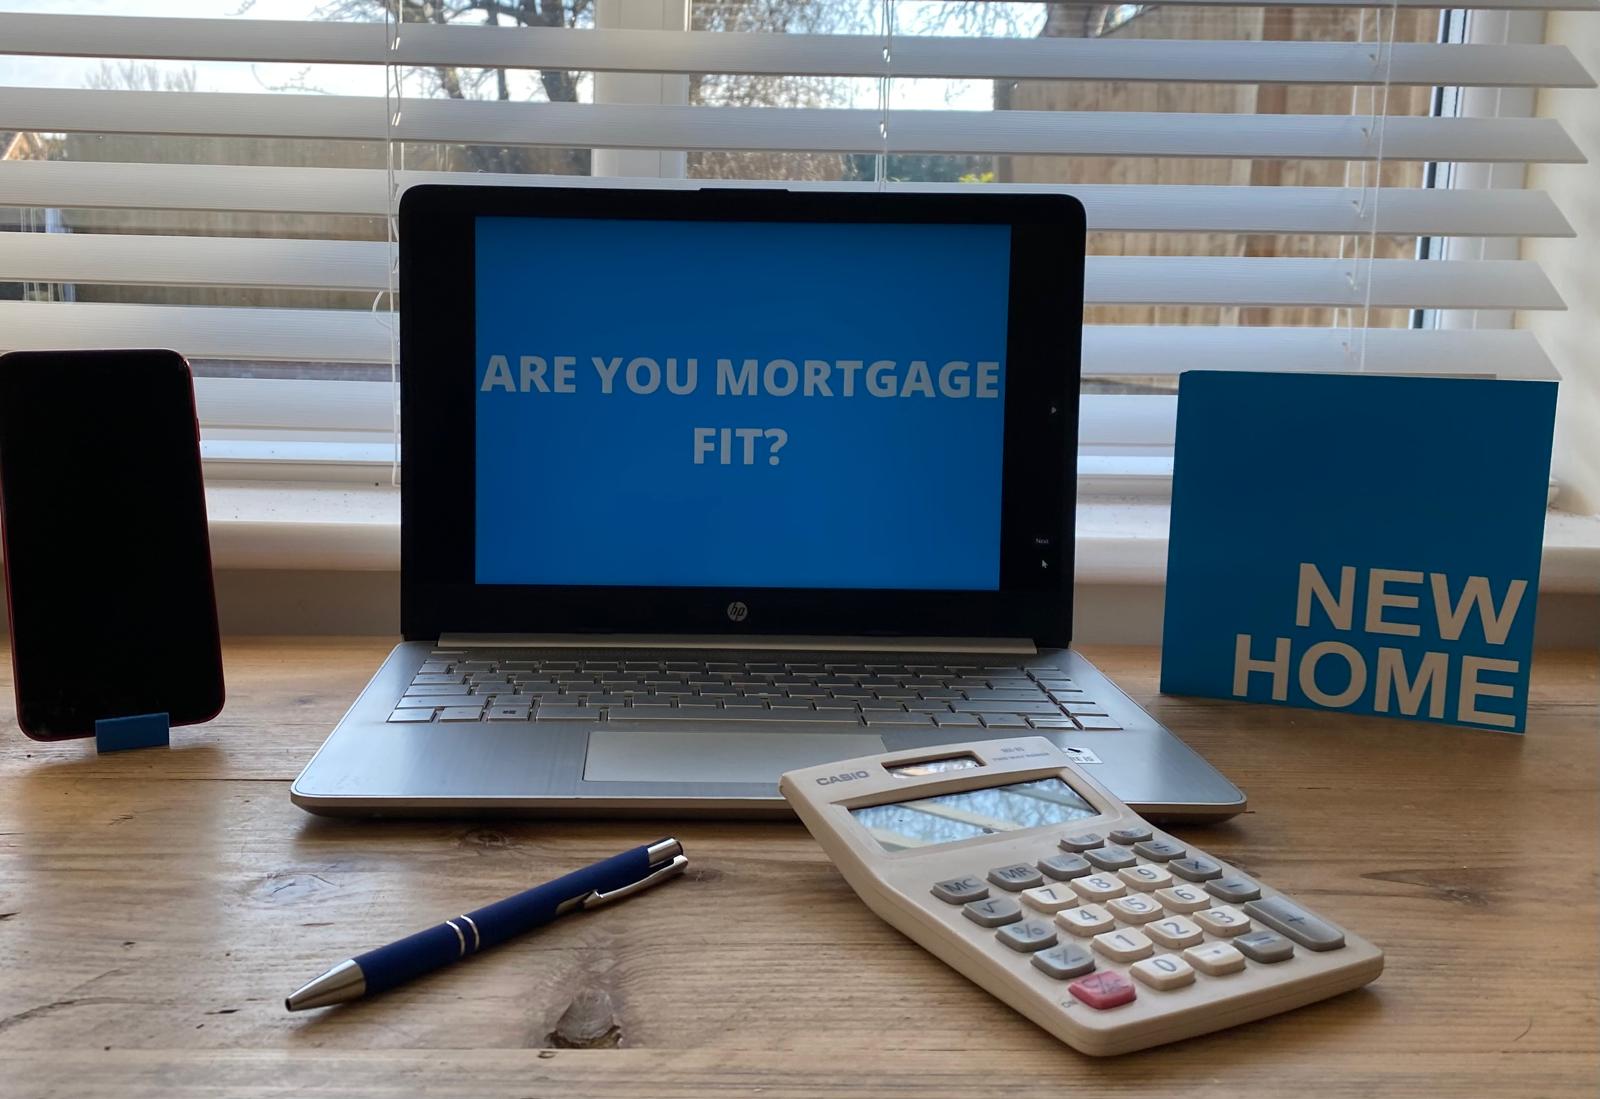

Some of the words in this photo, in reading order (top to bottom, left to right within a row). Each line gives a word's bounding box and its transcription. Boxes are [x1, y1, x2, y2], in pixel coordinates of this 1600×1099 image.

[480, 355, 576, 393] ARE
[592, 357, 698, 395] YOU
[716, 358, 999, 398] MORTGAGE
[693, 427, 788, 466] FIT?
[1296, 563, 1527, 645] NEW
[728, 601, 747, 623] hp
[1234, 634, 1518, 728] HOME
[815, 770, 870, 786] CASIO
[999, 866, 1035, 880] MR
[1136, 867, 1158, 880] 9
[943, 878, 981, 893] MC
[1089, 877, 1111, 889] 8
[1039, 888, 1057, 900] 7
[1174, 888, 1196, 901] 6
[1125, 898, 1148, 911] 5
[1079, 908, 1098, 921] 4
[1211, 910, 1235, 924] 3
[1163, 921, 1190, 935] 2
[1115, 934, 1137, 947] 1
[1152, 958, 1177, 973] 0
